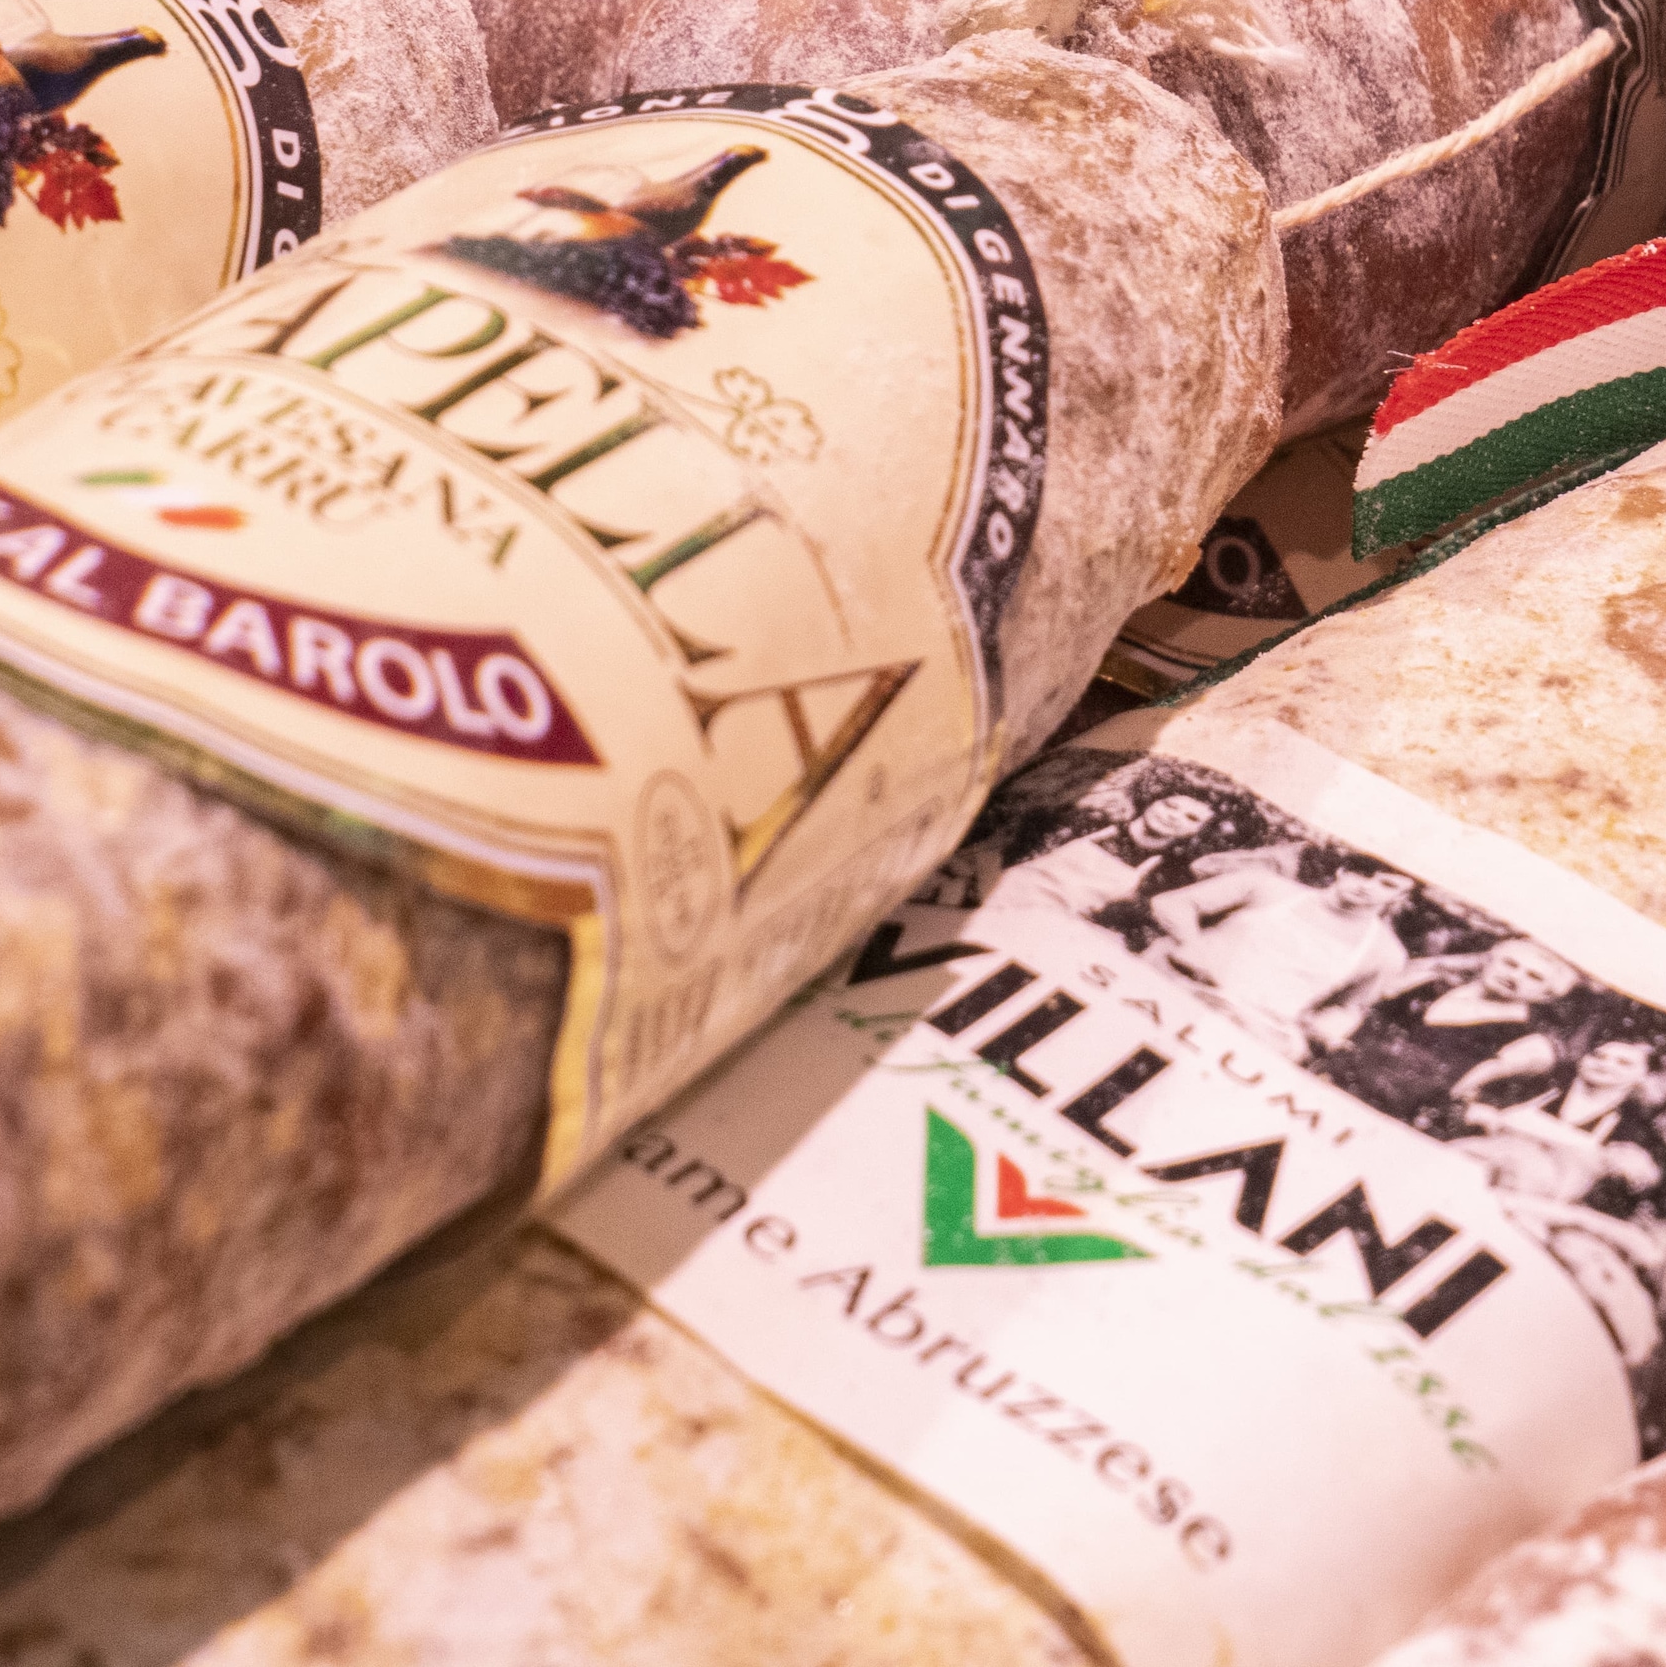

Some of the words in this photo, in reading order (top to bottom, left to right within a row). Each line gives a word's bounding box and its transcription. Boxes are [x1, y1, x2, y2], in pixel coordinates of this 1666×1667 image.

[270, 127, 308, 202] DI
[909, 161, 982, 213] DI
[971, 227, 1037, 564] GENNARO
[135, 572, 553, 742] BAROLO
[847, 922, 1511, 1341] VILLANI
[1078, 962, 1355, 1148] SALUMI
[796, 1260, 1237, 1574] Abruzzese
